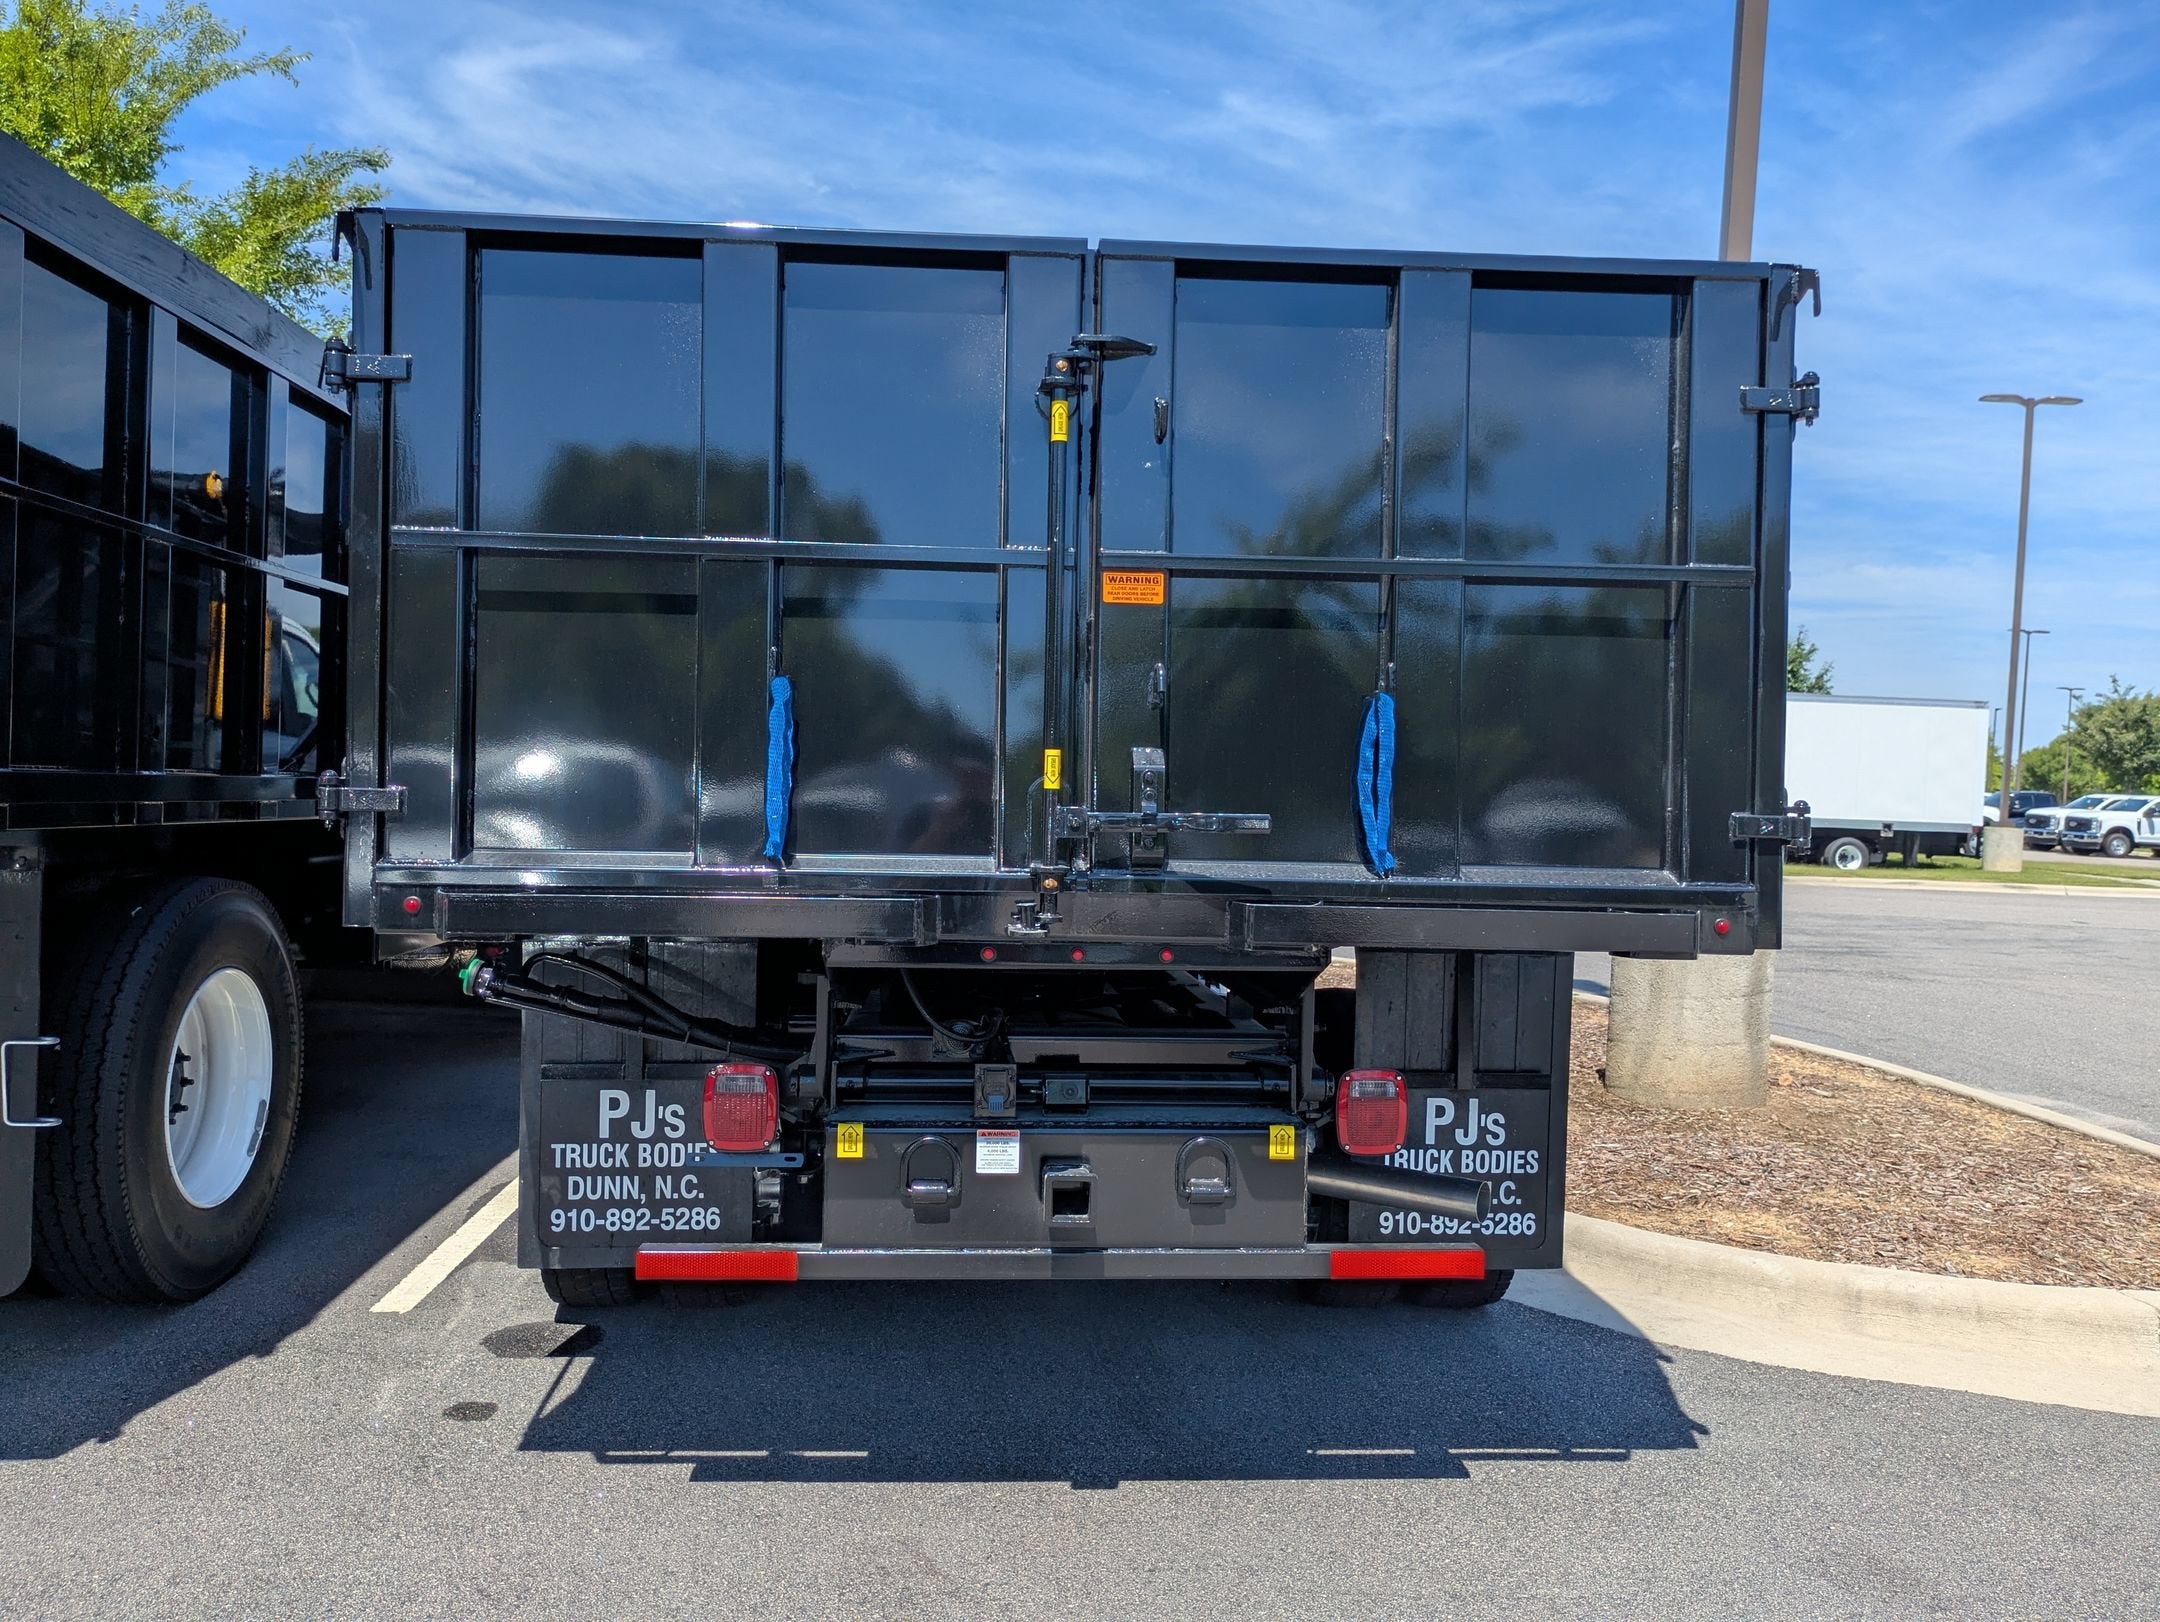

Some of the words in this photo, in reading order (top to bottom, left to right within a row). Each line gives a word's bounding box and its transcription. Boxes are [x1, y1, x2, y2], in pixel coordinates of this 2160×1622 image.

[1108, 575, 1159, 585] WARNING
[550, 1143, 630, 1168] TRUCK
[1461, 1150, 1539, 1174] BODIES
[567, 1175, 646, 1204] DUNN,
[655, 1174, 705, 1199] N.C.
[1487, 1181, 1522, 1205] .C.
[550, 1207, 721, 1232] 910-892-5286
